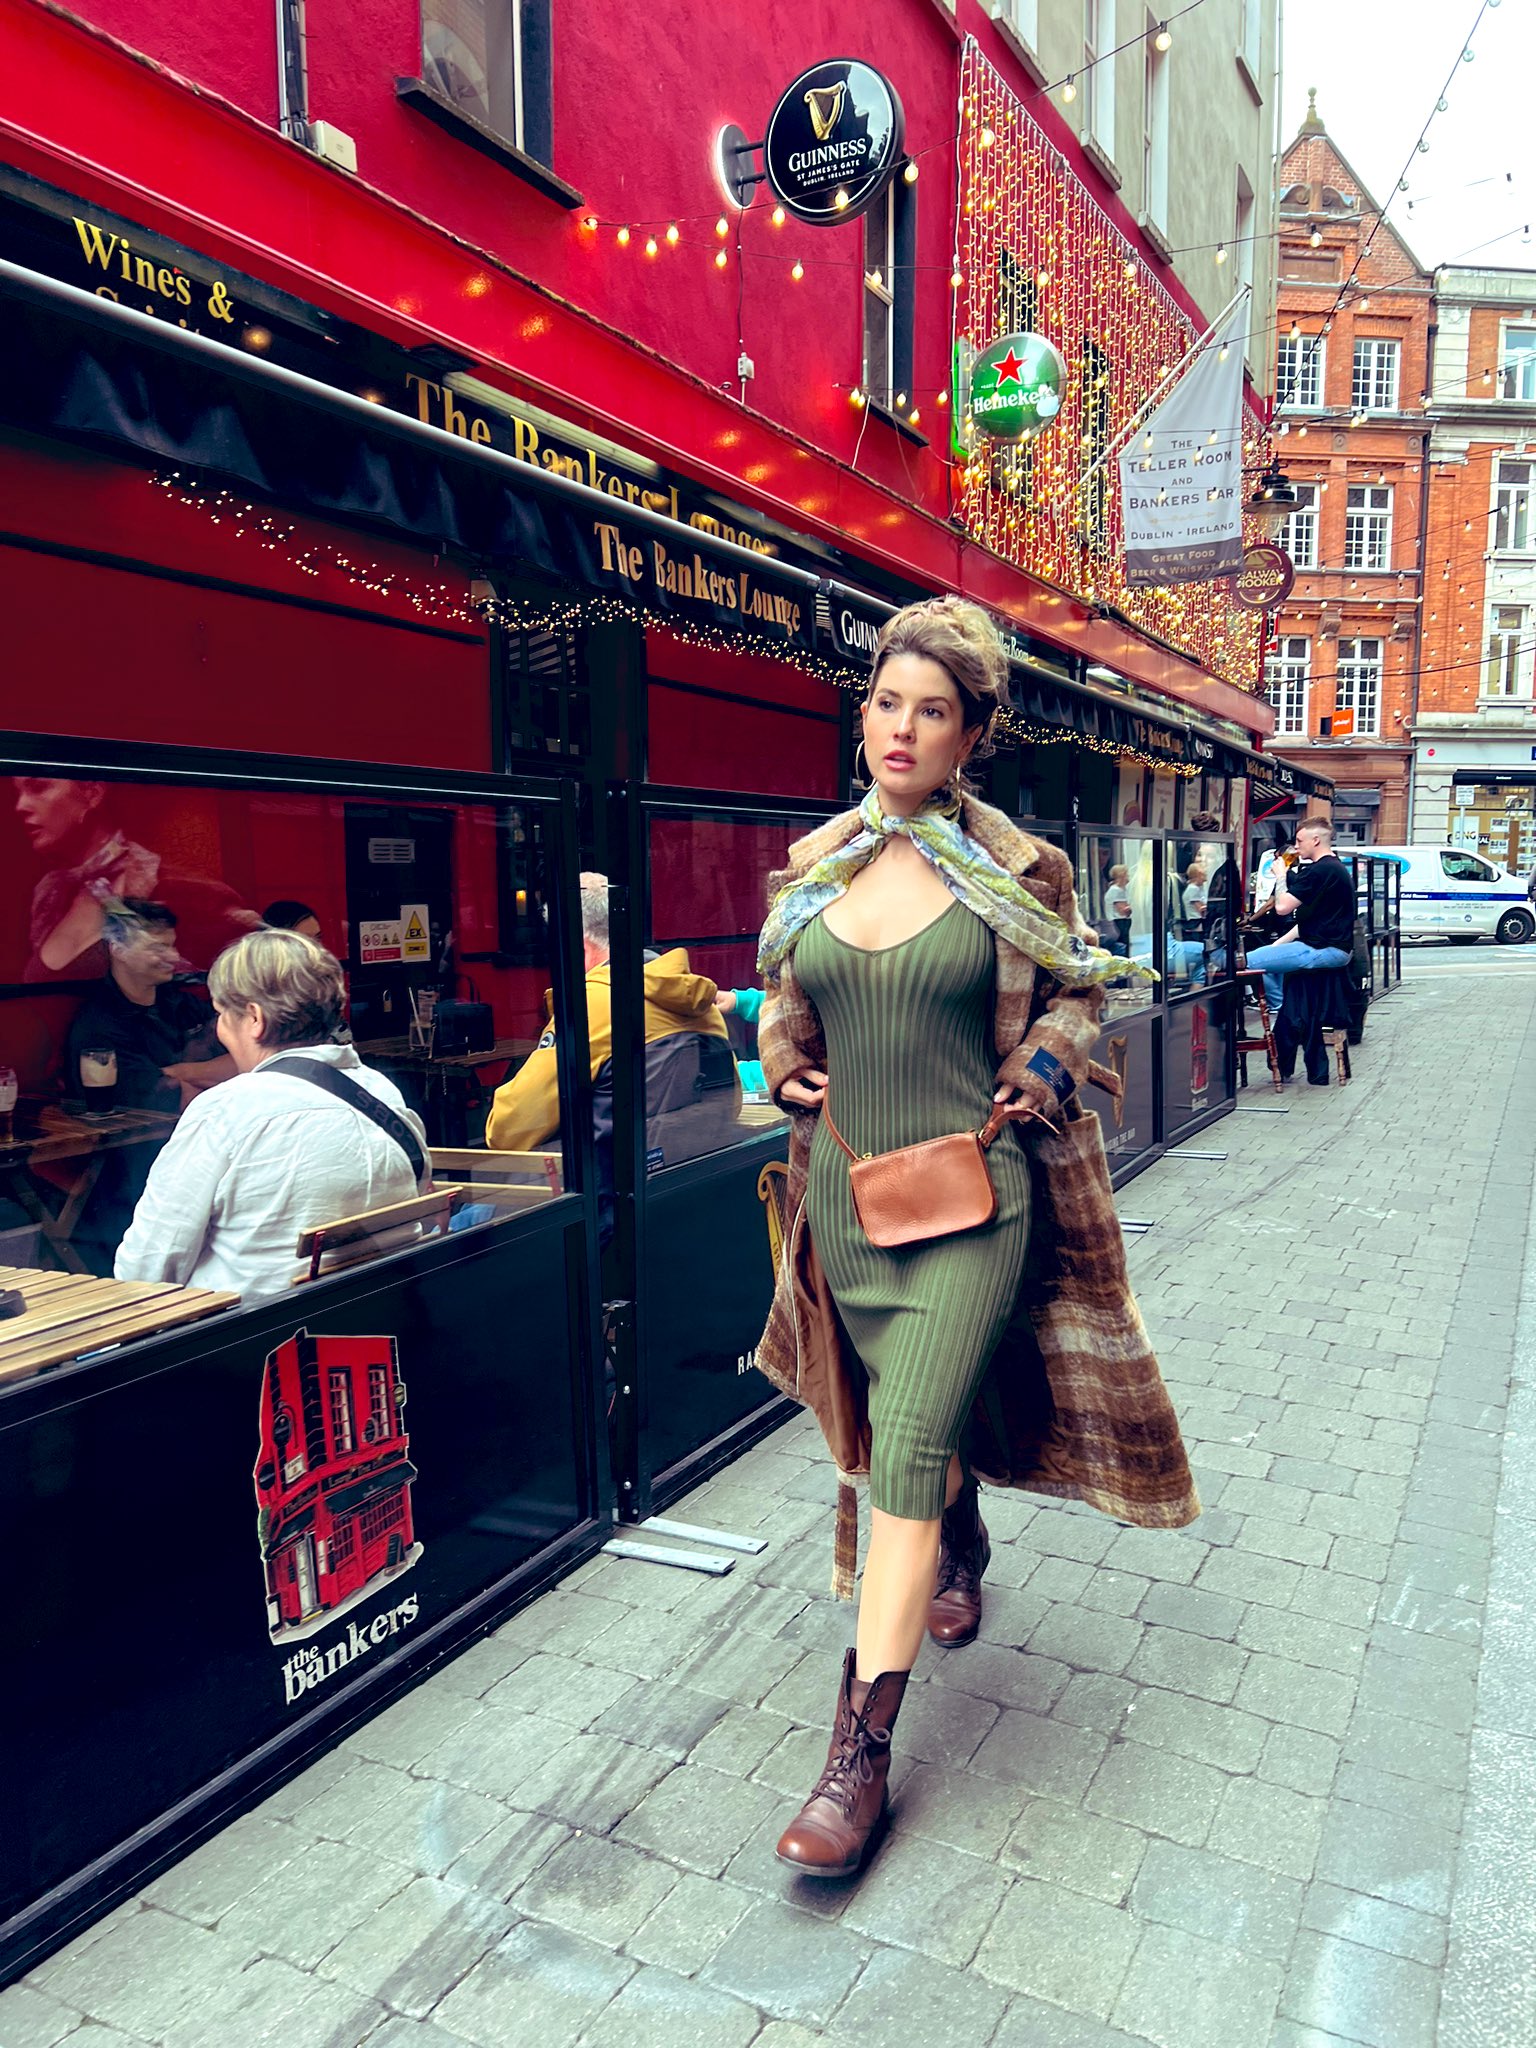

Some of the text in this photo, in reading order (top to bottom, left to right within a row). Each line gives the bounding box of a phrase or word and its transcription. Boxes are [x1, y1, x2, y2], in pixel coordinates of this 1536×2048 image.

[788, 138, 867, 172] GUINNESS
[796, 159, 860, 182] ST JAMES'S GATE
[828, 169, 855, 179] IRELAND
[72, 215, 191, 306] Wines
[208, 280, 234, 323] &
[973, 384, 1053, 415] Heineke
[406, 372, 492, 443] The
[510, 415, 661, 512] Bankers
[1171, 439, 1193, 449] THE
[1128, 458, 1187, 473] TELLER
[1171, 477, 1193, 486] AND
[1129, 493, 1200, 509] BANKERS
[1130, 531, 1174, 540] DUBLIN
[1187, 522, 1234, 536] IRELAND
[1151, 549, 1216, 563] GREAT FOOD
[594, 522, 800, 637] The Bankers Lounge
[1130, 568, 1156, 578] BEER
[1159, 567, 1167, 576] &
[1169, 563, 1216, 575] WHISKEY
[841, 610, 880, 652] GUINN
[409, 928, 421, 937] EX
[281, 1592, 419, 1705] bankers
[293, 1645, 319, 1669] the
